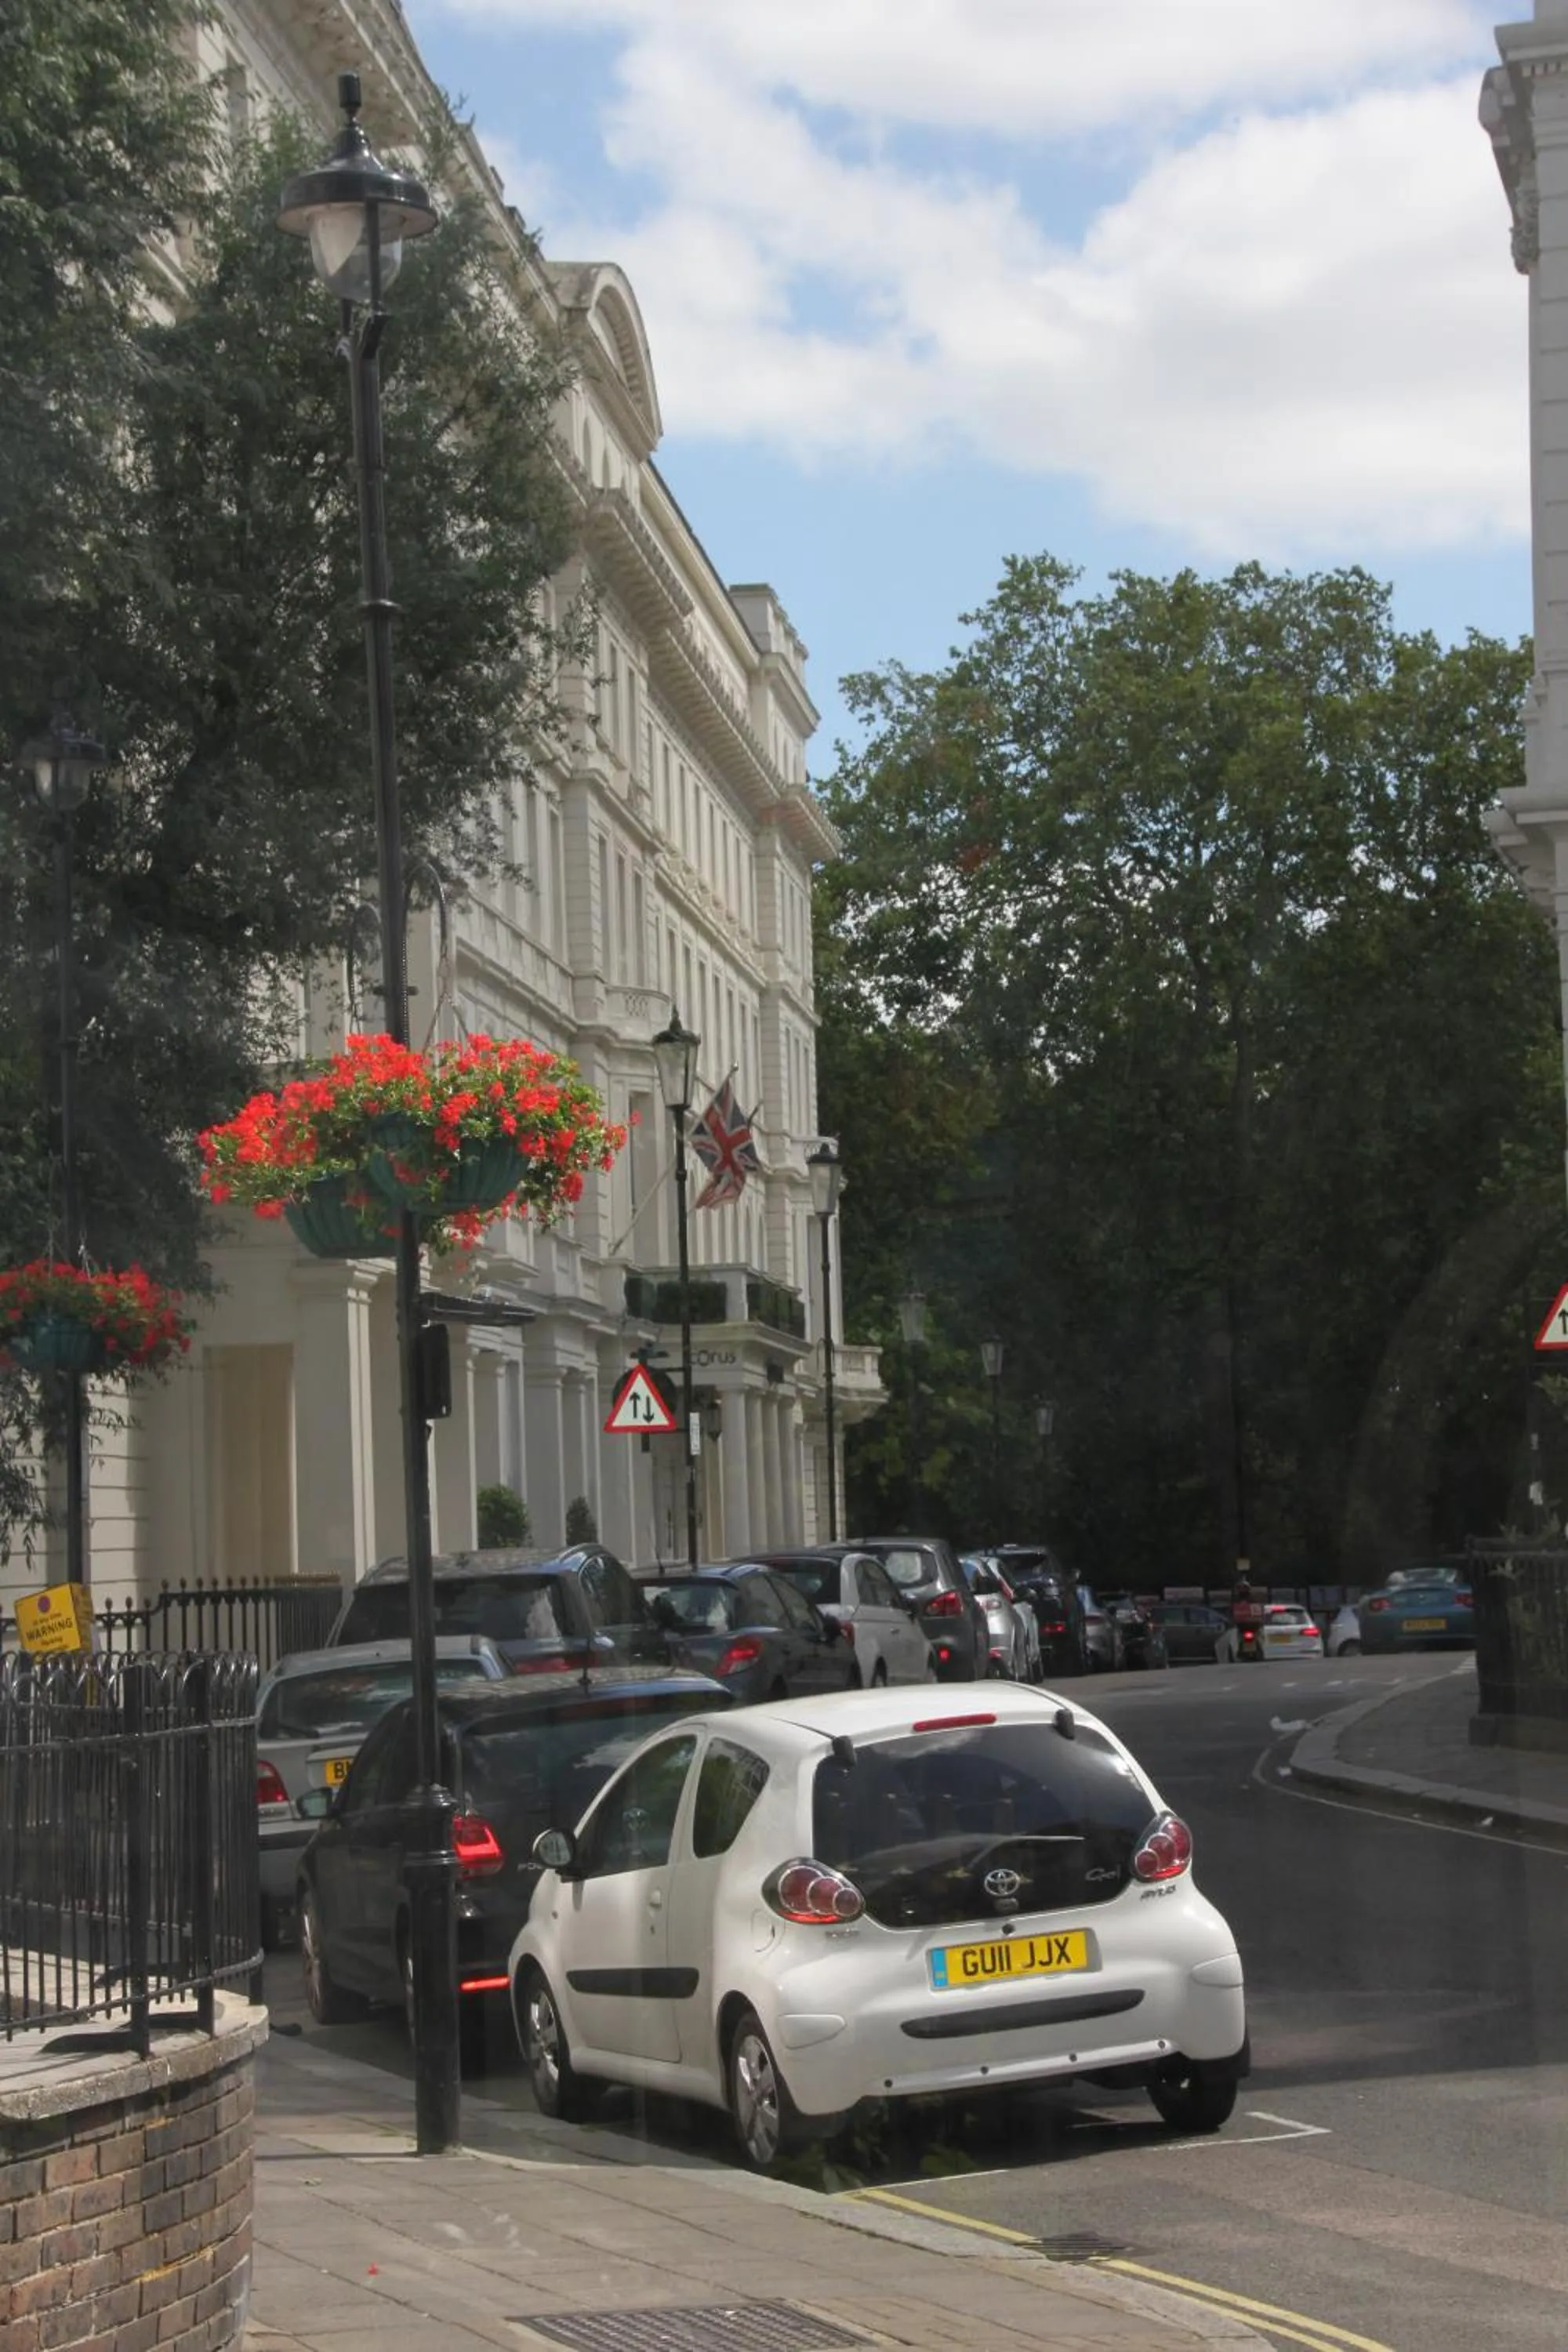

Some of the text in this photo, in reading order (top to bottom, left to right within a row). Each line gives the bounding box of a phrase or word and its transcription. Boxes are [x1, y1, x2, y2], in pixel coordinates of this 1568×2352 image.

[26, 1617, 74, 1642] WARNING
[962, 1936, 1073, 1976] GU11 JJX
